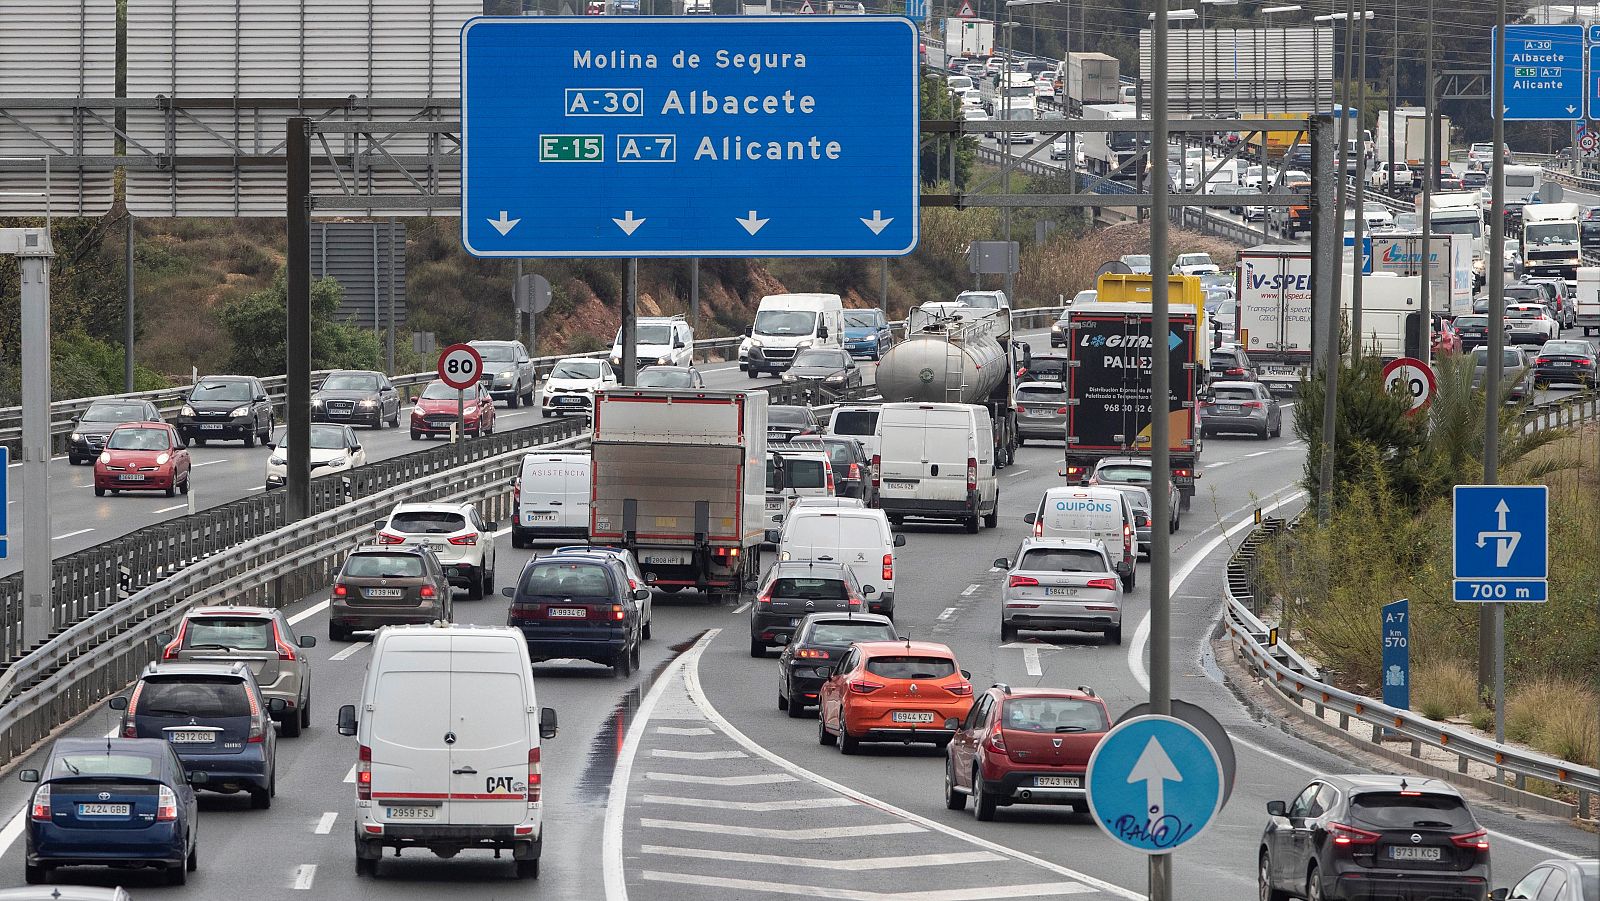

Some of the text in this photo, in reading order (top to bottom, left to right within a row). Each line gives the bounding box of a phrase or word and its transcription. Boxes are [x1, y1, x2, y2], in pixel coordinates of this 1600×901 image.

[573, 49, 806, 74] Molina de Segura
[1512, 53, 1564, 62] Albacete
[1516, 68, 1559, 76] E-15 A-7
[1513, 80, 1563, 89] Alicante
[570, 89, 815, 115] A-30 Albacete
[543, 136, 841, 160] E-15 A-7 Alicante
[447, 359, 474, 374] 80
[1103, 403, 1120, 412] 968
[531, 469, 585, 477] ASISTENCIA
[1056, 501, 1112, 513] QUIPONS
[369, 588, 400, 597] 2139 HMV
[1470, 584, 1530, 598] 700 m
[1385, 612, 1405, 623] A-7
[1385, 637, 1407, 648] 570
[896, 712, 934, 722] 6944 KZV
[175, 732, 213, 741] 2912 GCL
[486, 776, 514, 794] CAT
[1038, 777, 1079, 786] 9743 HKK
[83, 804, 128, 814] 2424 GBB
[392, 808, 435, 818] 2959 FSJ
[1395, 846, 1440, 860] 9731 KCS
